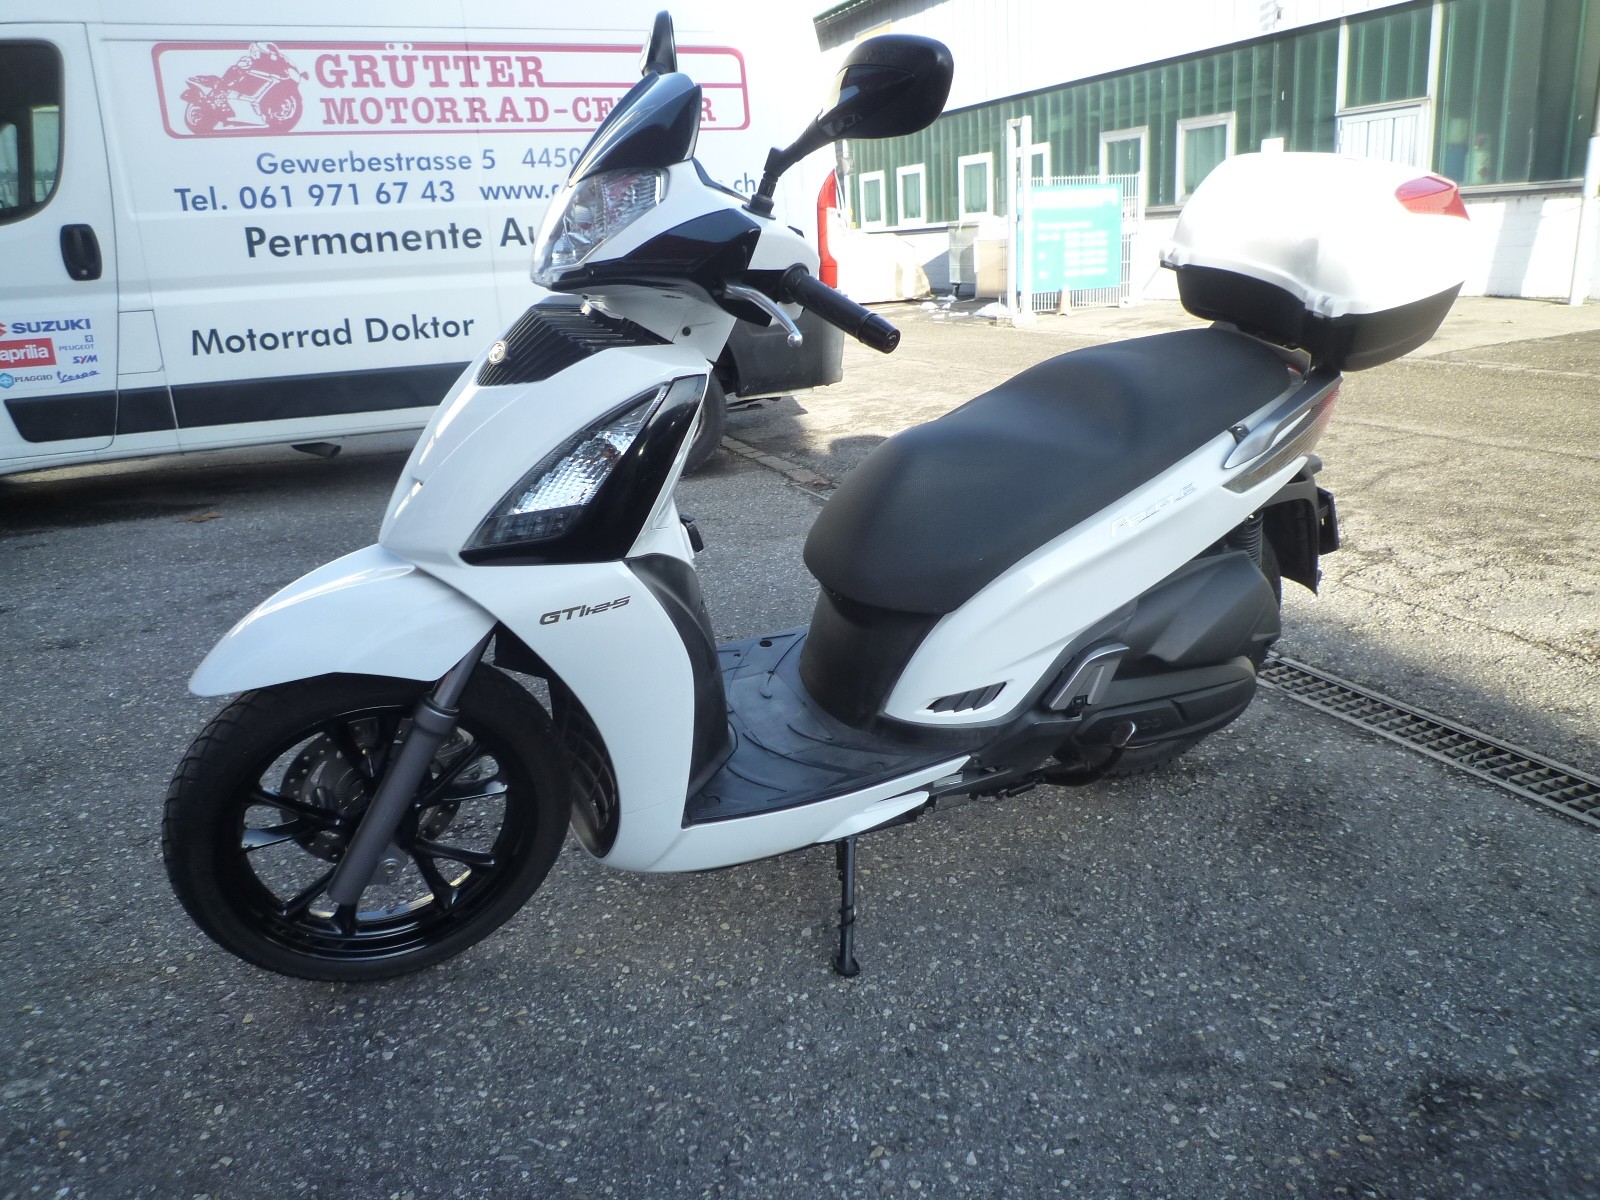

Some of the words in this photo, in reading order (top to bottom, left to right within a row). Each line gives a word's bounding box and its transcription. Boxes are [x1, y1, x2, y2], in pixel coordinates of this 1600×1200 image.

[314, 43, 544, 88] GRÜTTER
[256, 150, 472, 174] Gewerbestrasse
[482, 149, 496, 170] 5
[522, 147, 581, 168] 4450
[173, 185, 228, 211] Tel.
[239, 185, 292, 210] 061
[308, 183, 359, 207] 971
[375, 182, 409, 205] 67
[421, 180, 455, 203] 43
[244, 222, 483, 258] Permanente
[11, 318, 92, 334] SUZUKI
[191, 318, 353, 356] Motorrad
[364, 314, 475, 343] Doktor
[0, 344, 49, 363] aprilia
[58, 344, 94, 352] PEUGEOT
[72, 354, 98, 364] SYM
[14, 374, 53, 383] PIAGGIO
[56, 370, 101, 384] Vespa
